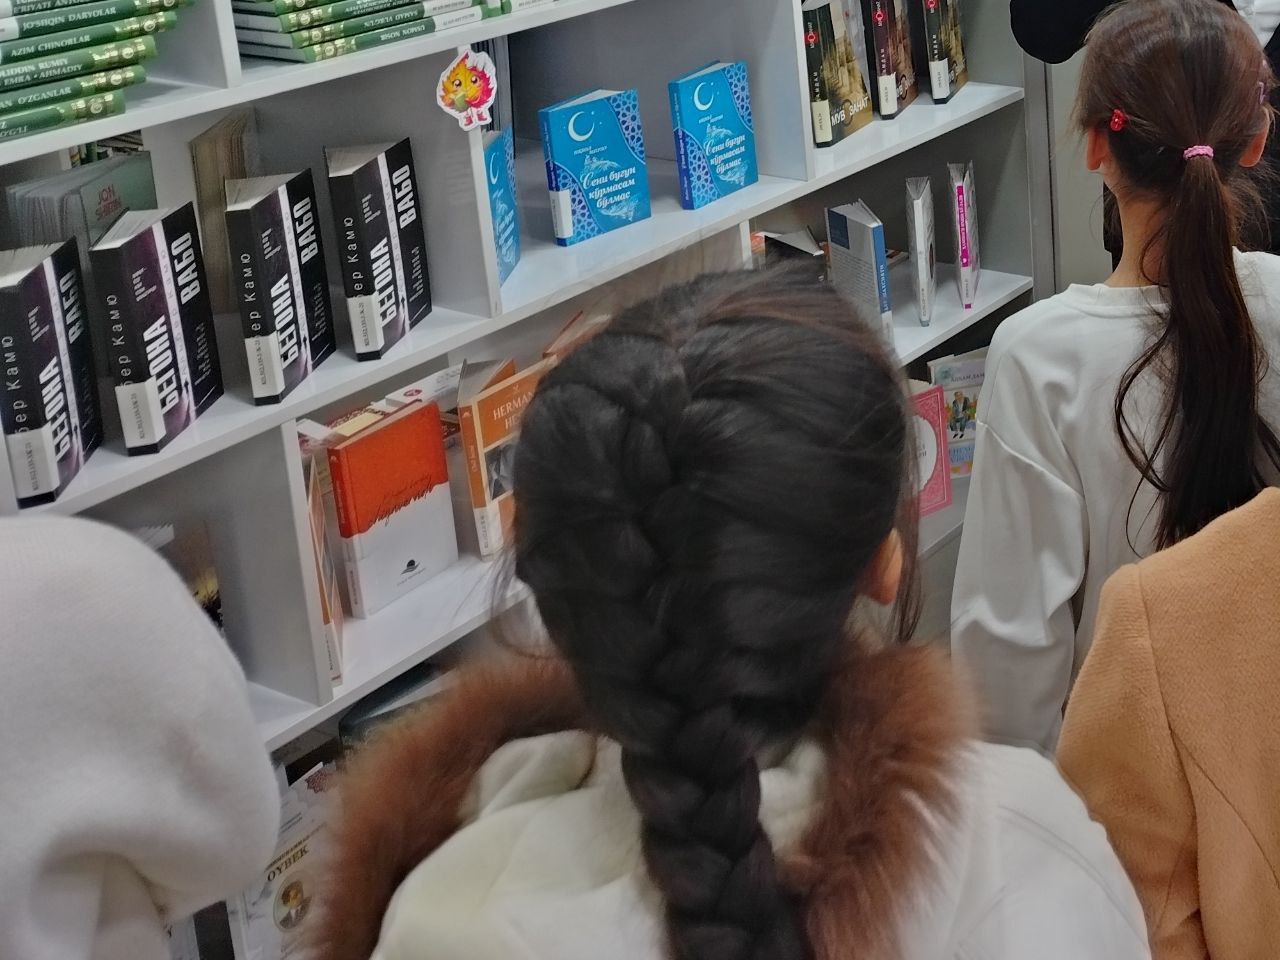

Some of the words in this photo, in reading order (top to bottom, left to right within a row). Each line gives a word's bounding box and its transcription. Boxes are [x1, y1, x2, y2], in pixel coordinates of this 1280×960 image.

[293, 196, 318, 265] ВАБО
[392, 164, 417, 230] ВАБО
[171, 232, 200, 305] ВАБО
[343, 217, 358, 263] Камю
[60, 267, 84, 344] ВАБО
[240, 253, 257, 302] Камю
[370, 237, 396, 327] БЕГОНА
[107, 294, 126, 347] Камю
[271, 273, 298, 370] БЕГОНА
[2, 335, 22, 391] Камю
[143, 314, 180, 416] БЕГОНА
[39, 356, 71, 463] БЕГОНА
[267, 844, 310, 882] OYBEK
